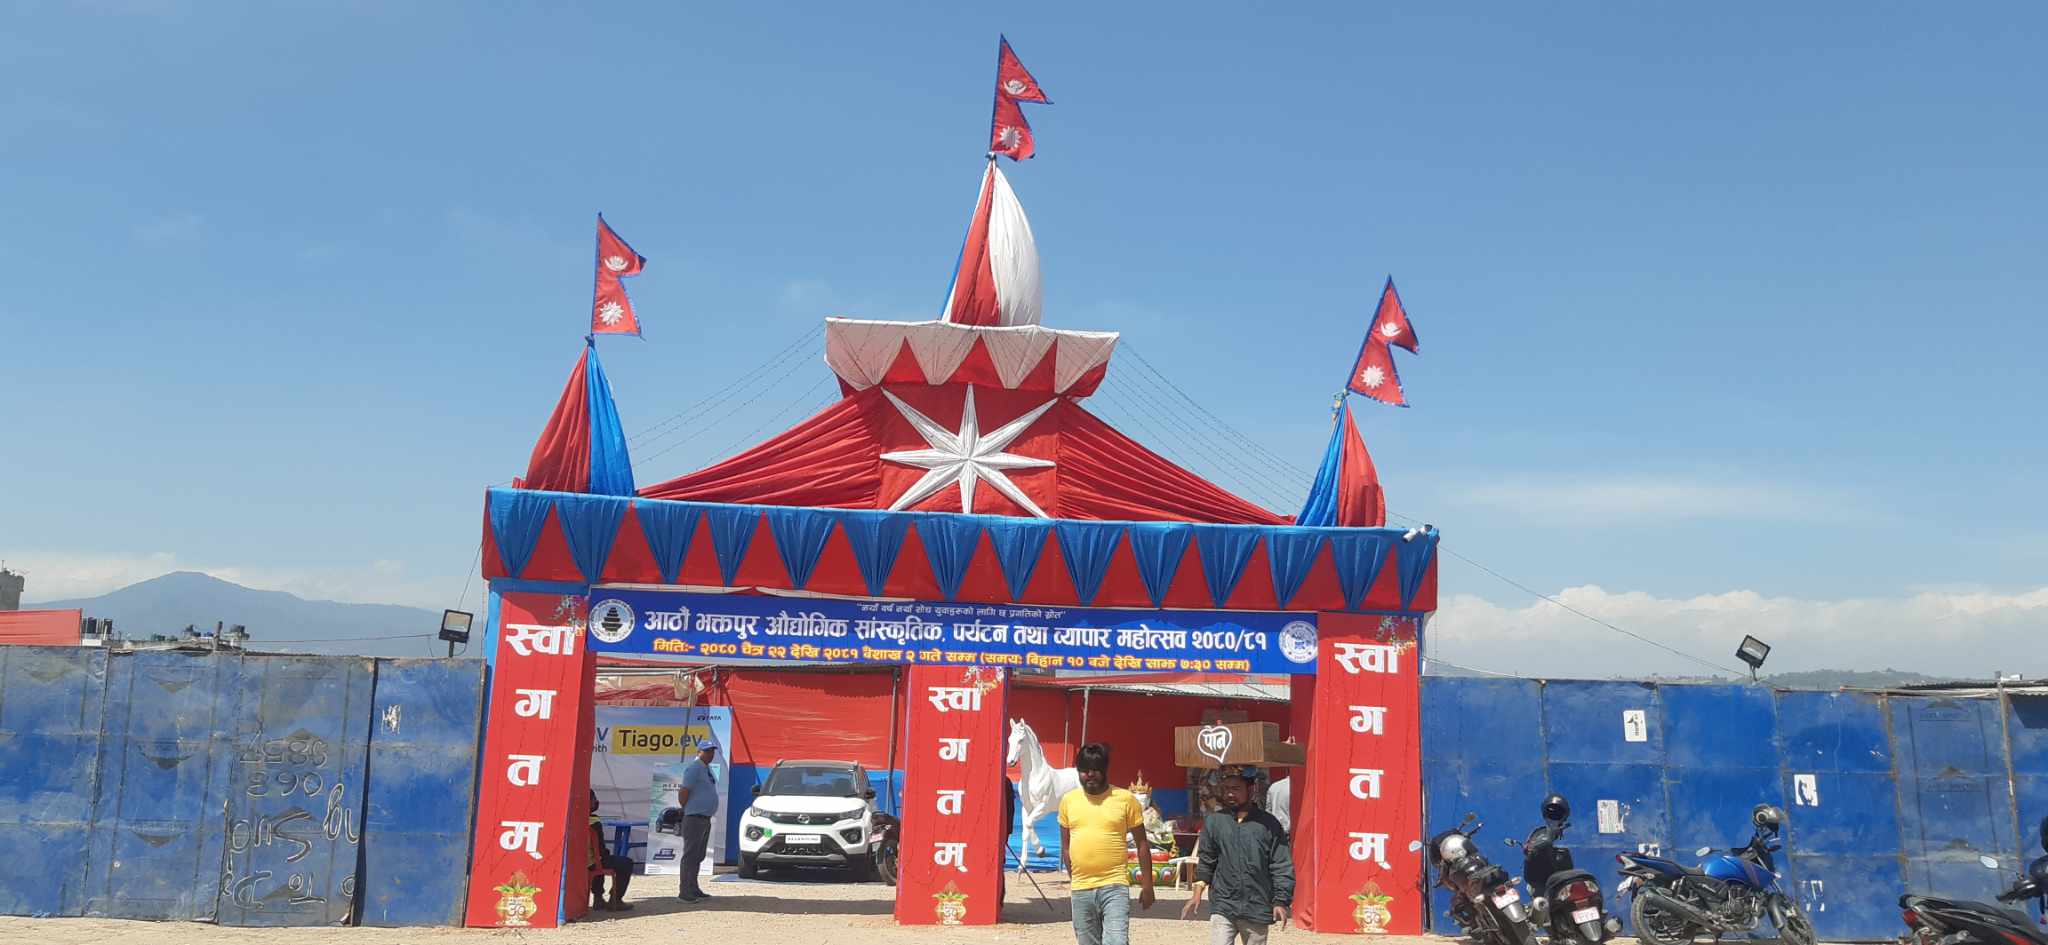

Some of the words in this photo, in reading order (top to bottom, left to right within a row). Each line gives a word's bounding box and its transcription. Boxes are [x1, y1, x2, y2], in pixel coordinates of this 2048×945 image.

[696, 613, 760, 640] भक्तपुर
[765, 610, 849, 637] औद्योगिक
[953, 619, 1009, 643] पर्यटन
[1014, 625, 1049, 645] तथा
[1053, 627, 1112, 648] व्यापार
[1117, 624, 1187, 650] महोत्सव
[1191, 629, 1267, 653] २०८०/८१
[700, 643, 736, 655] २०८०
[741, 641, 765, 656] चैत्र
[768, 646, 786, 658] २२
[790, 643, 820, 659] देखि
[823, 648, 858, 660] २०८१
[905, 650, 915, 663] २
[919, 648, 941, 662] गते
[945, 652, 976, 663] सम्म
[1026, 652, 1063, 668] बिहान
[1067, 656, 1084, 667] १०
[1088, 654, 1110, 668] बजे
[1113, 655, 1143, 669] देखि
[1215, 660, 1250, 672] सम्म)
[619, 729, 703, 751] Tiago.ev
[1203, 731, 1227, 752] पान
